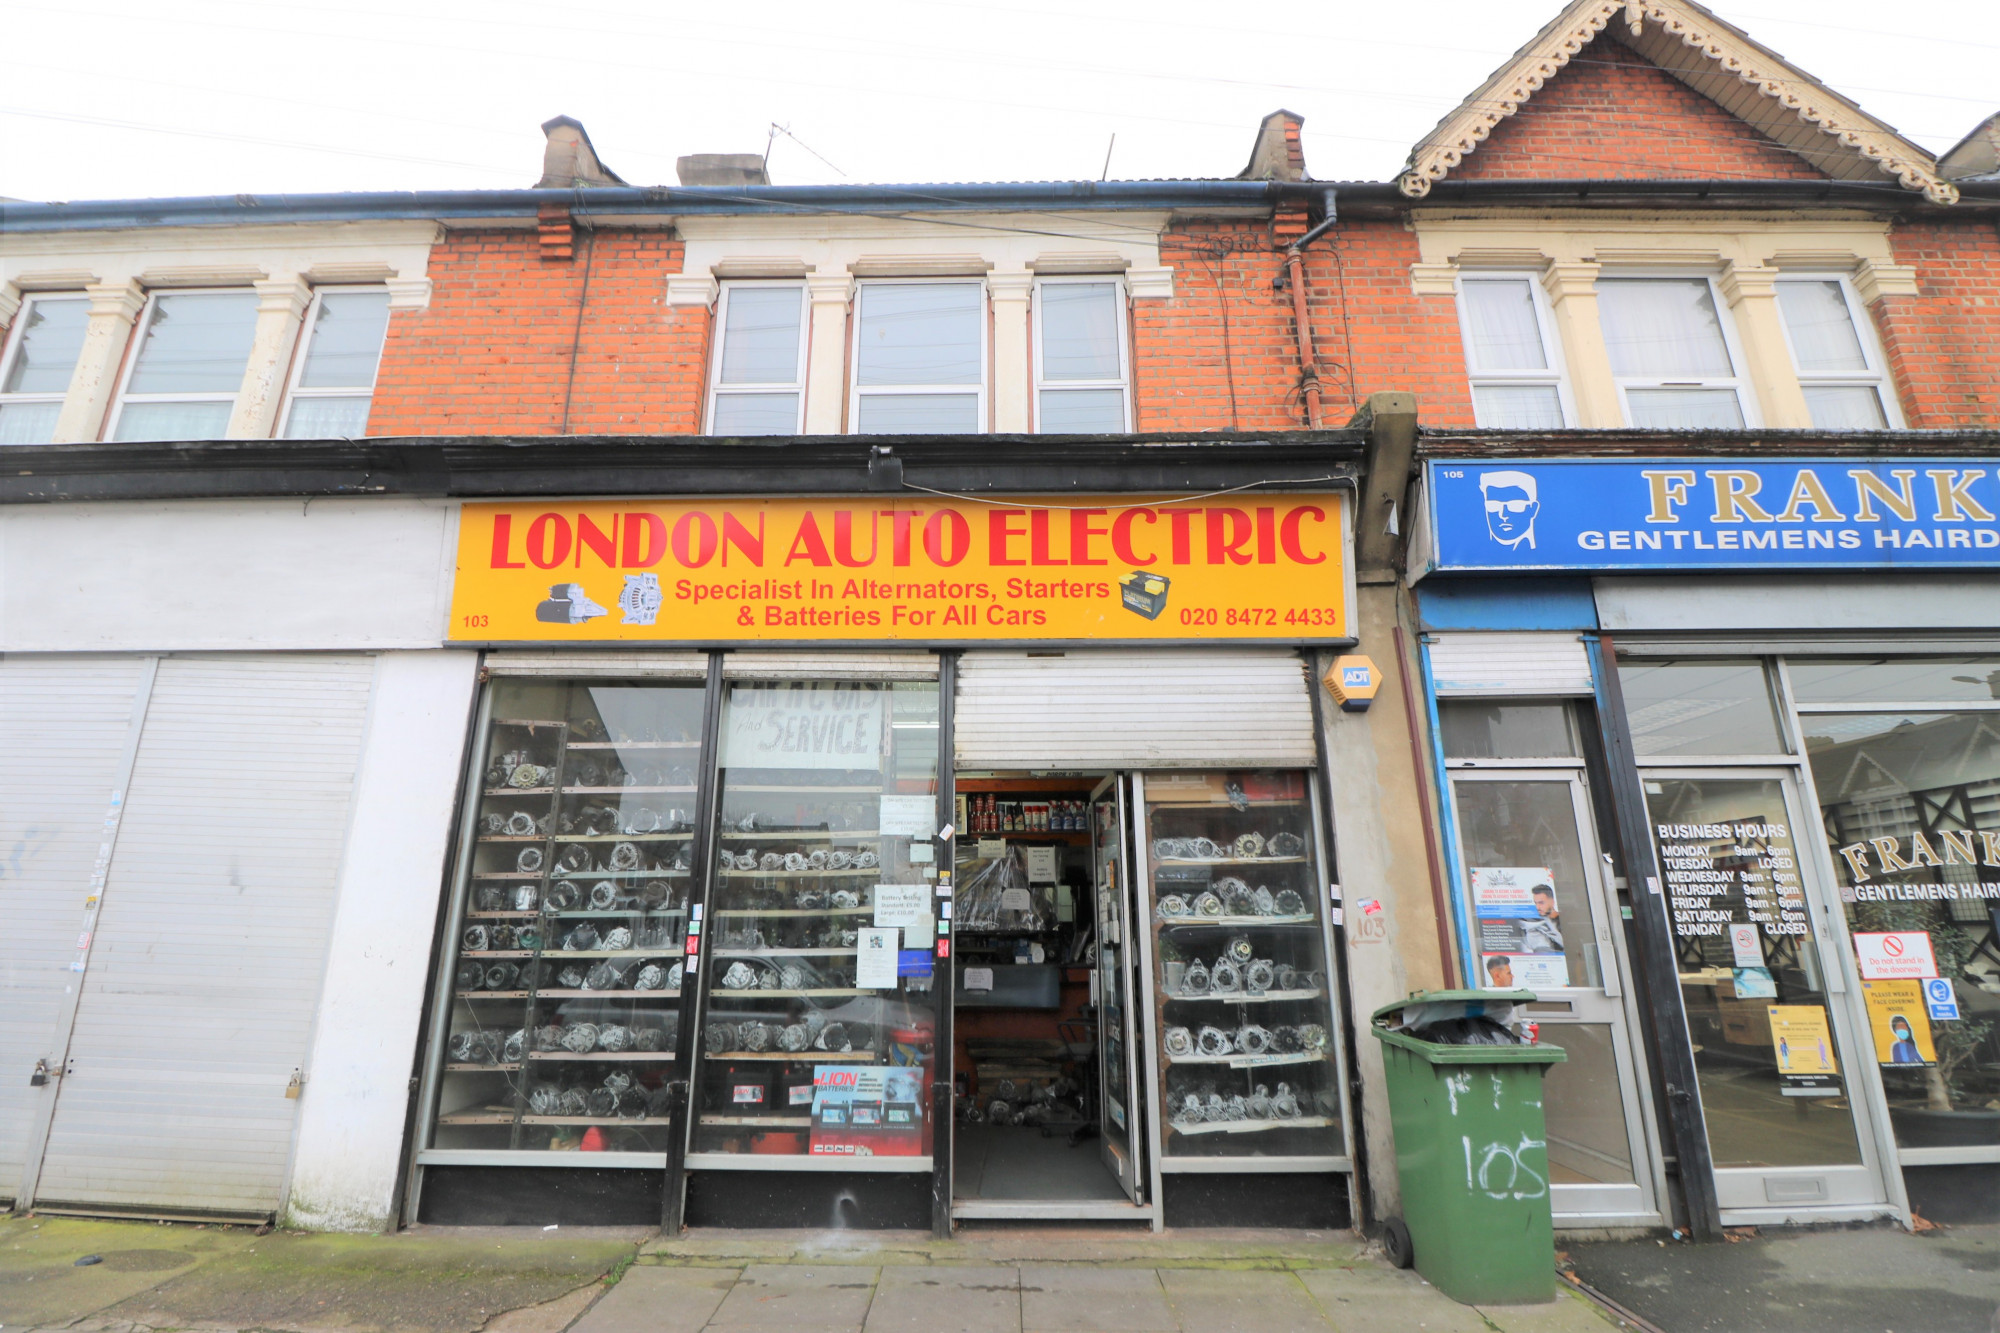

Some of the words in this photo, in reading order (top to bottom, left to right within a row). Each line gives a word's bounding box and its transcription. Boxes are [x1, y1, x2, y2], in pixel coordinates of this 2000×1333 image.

[1443, 471, 1464, 479] 105
[490, 511, 765, 569] LONDON
[784, 509, 970, 567] AUTO
[989, 505, 1327, 567] ELECTRIC
[1577, 530, 1861, 550] GENTLEMENS
[675, 579, 802, 605] Specialist
[811, 579, 834, 599] In
[841, 578, 997, 602] Alternators,
[1006, 577, 1110, 598] Starters
[463, 615, 489, 628] 103
[736, 605, 755, 626] &
[765, 605, 881, 626] Batteries
[892, 605, 936, 626] For
[943, 605, 977, 626] All
[986, 605, 1047, 625] Cars
[1180, 608, 1218, 626] 020
[1226, 607, 1277, 625] 8472
[1284, 607, 1336, 625] 4433
[1344, 670, 1370, 683] ADT
[758, 710, 869, 754] SERVICE
[1658, 824, 1731, 839] BUSINESS
[1734, 823, 1787, 839] HOURS
[1661, 845, 1710, 857] MONDAY
[1734, 845, 1758, 857] 9am
[1767, 845, 1791, 859] 6pm
[1663, 858, 1714, 869] TUESDAY
[1758, 857, 1793, 869] LOSED
[1666, 871, 1735, 882] WEDNESDAY
[1740, 871, 1764, 882] 9am
[1772, 871, 1796, 884] 6pm
[1668, 884, 1728, 895] THURSDAY
[1743, 884, 1766, 895] 9am
[1775, 884, 1799, 897] 6pm
[1854, 883, 1959, 901] GENTLEMENS
[1671, 897, 1711, 909] FRIDAY
[1745, 897, 1769, 908] 9am
[1778, 897, 1802, 910] 6pm
[1674, 910, 1733, 922] SATURDAY
[1748, 910, 1772, 922] 9am
[1781, 910, 1806, 923] 6pm
[1357, 917, 1386, 938] 103
[1677, 923, 1722, 935] SUNDAY
[1765, 923, 1808, 935] CLOSED
[1869, 957, 1880, 965] Do
[1882, 957, 1894, 965] not
[1896, 956, 1916, 965] stand
[1917, 956, 1925, 964] in
[1876, 965, 1889, 973] the
[1890, 965, 1922, 975] doorway
[820, 1072, 858, 1086] LION
[818, 1085, 854, 1093] BATTERIES
